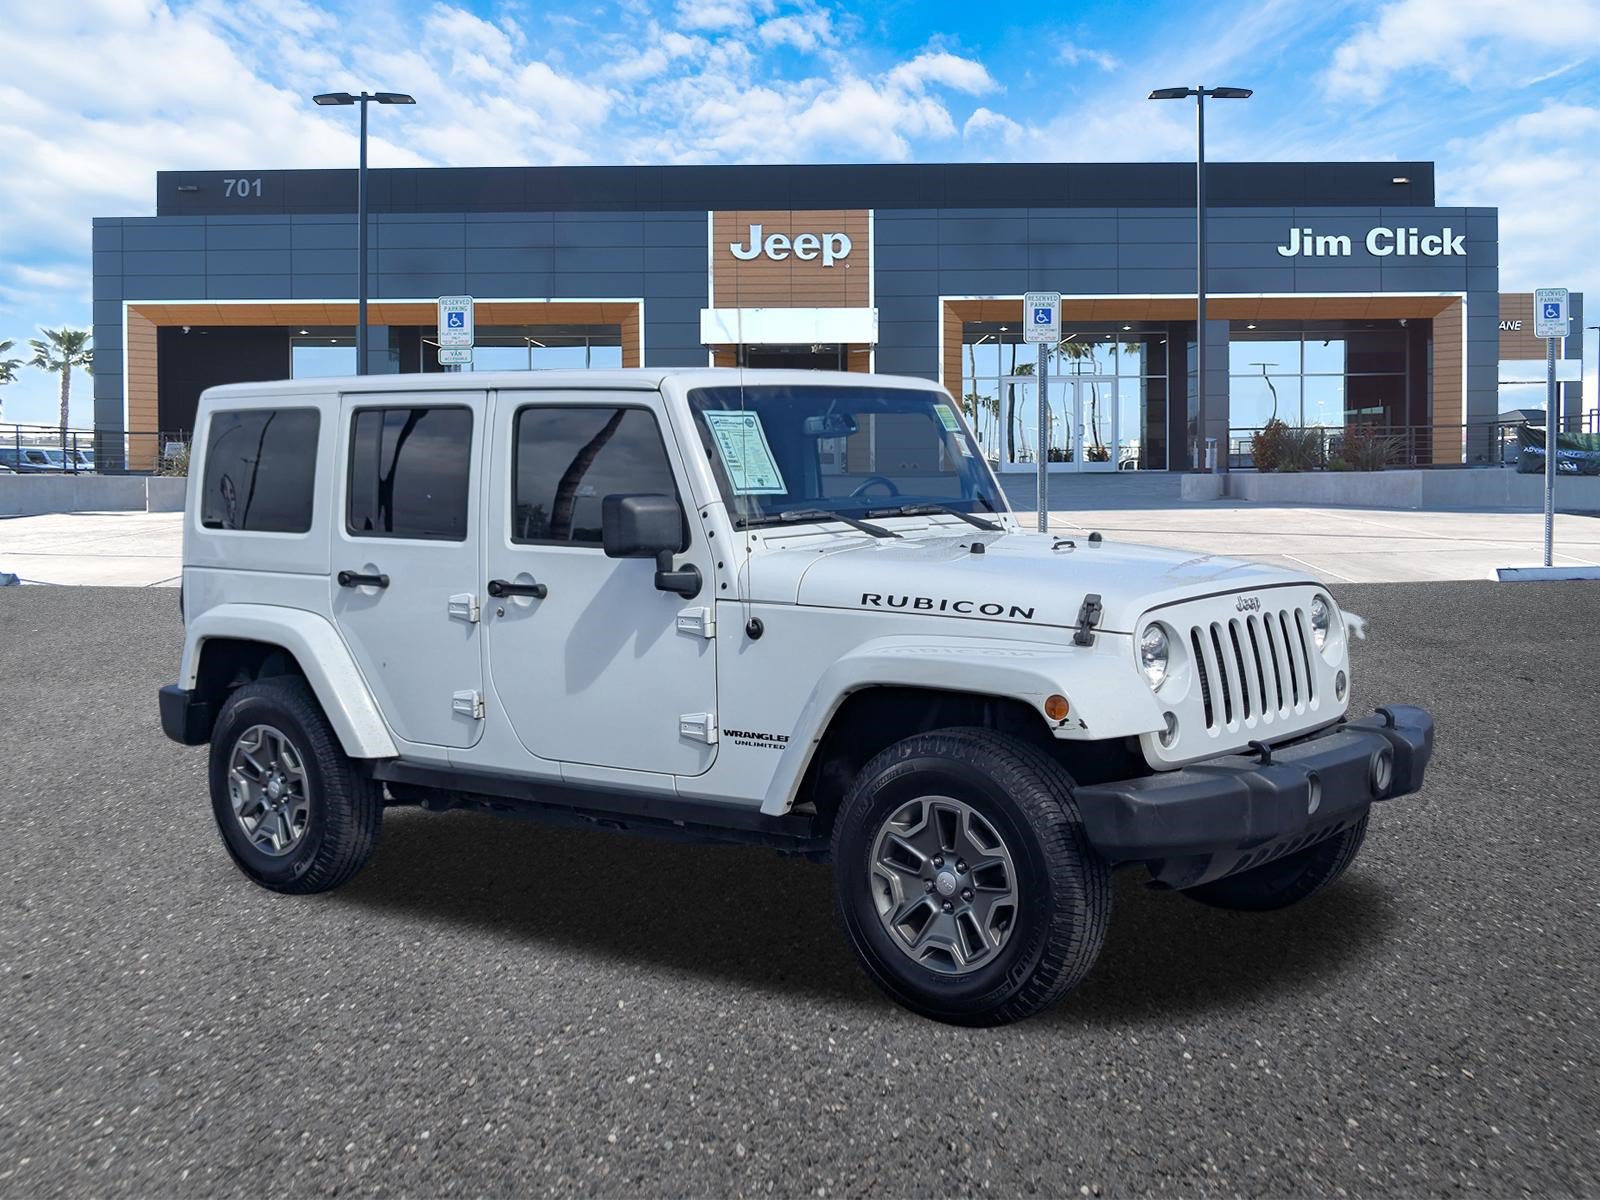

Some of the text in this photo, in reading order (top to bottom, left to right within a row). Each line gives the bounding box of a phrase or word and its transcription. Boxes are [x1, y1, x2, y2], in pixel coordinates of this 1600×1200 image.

[223, 178, 262, 197] 701
[729, 223, 852, 267] Jeep
[1277, 227, 1467, 257] Jim Click
[860, 592, 1035, 619] RUBICON
[1235, 595, 1261, 613] Jeep
[734, 740, 786, 750] UNLIMITED
